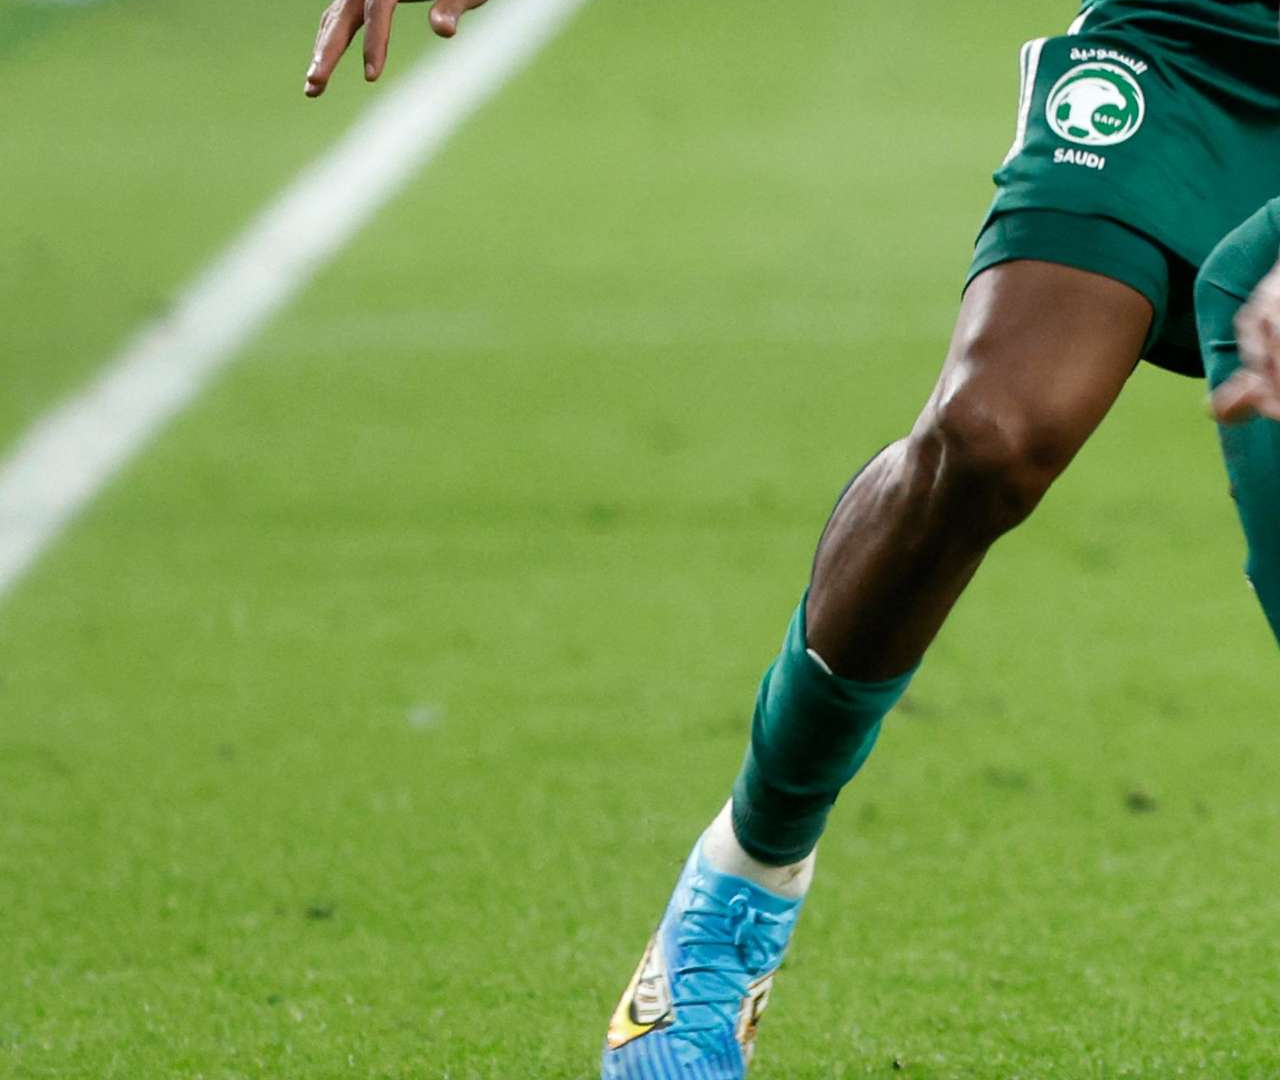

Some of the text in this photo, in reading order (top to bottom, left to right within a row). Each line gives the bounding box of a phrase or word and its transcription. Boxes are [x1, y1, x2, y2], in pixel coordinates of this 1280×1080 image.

[1070, 47, 1148, 75] السعودية
[1093, 112, 1122, 128] SAFF
[1053, 148, 1105, 170] SAUDI
